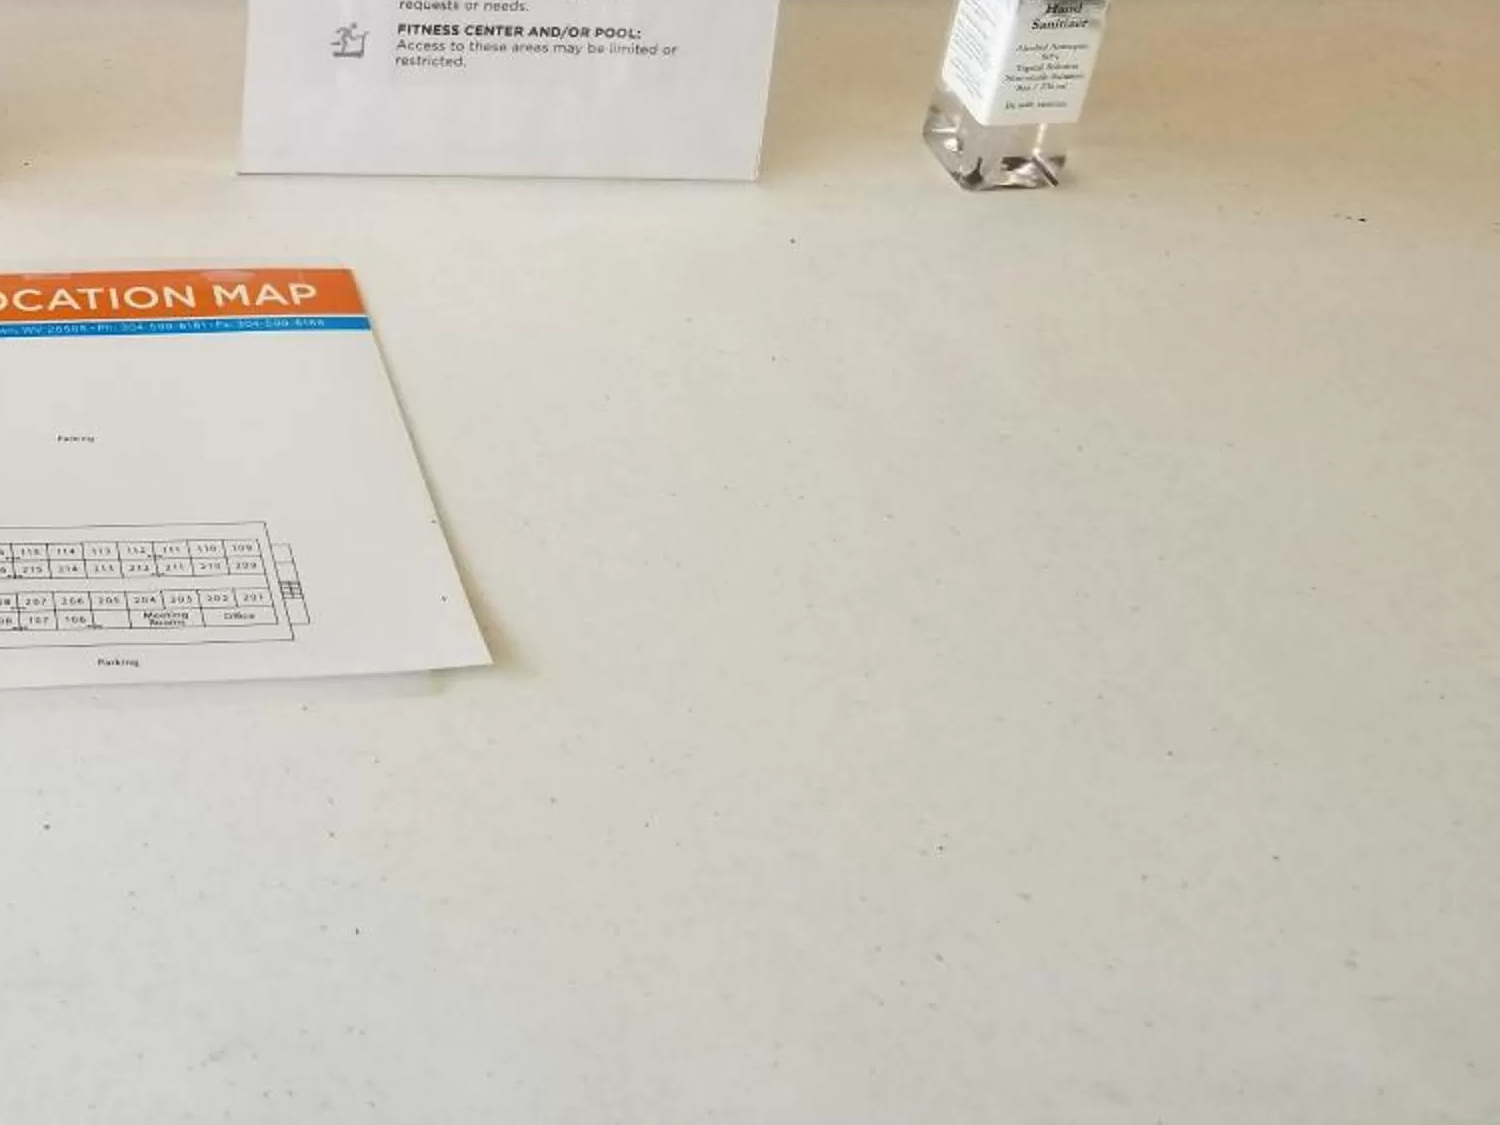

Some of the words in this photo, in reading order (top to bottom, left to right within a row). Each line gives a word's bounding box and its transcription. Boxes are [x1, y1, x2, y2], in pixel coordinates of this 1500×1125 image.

[398, 24, 459, 35] FITNESS
[464, 25, 524, 36] CENTER
[528, 27, 590, 37] AND/OR
[595, 27, 641, 39] POOL:
[212, 282, 318, 307] MAP
[57, 435, 94, 443] Parking
[97, 659, 139, 667] Parking
